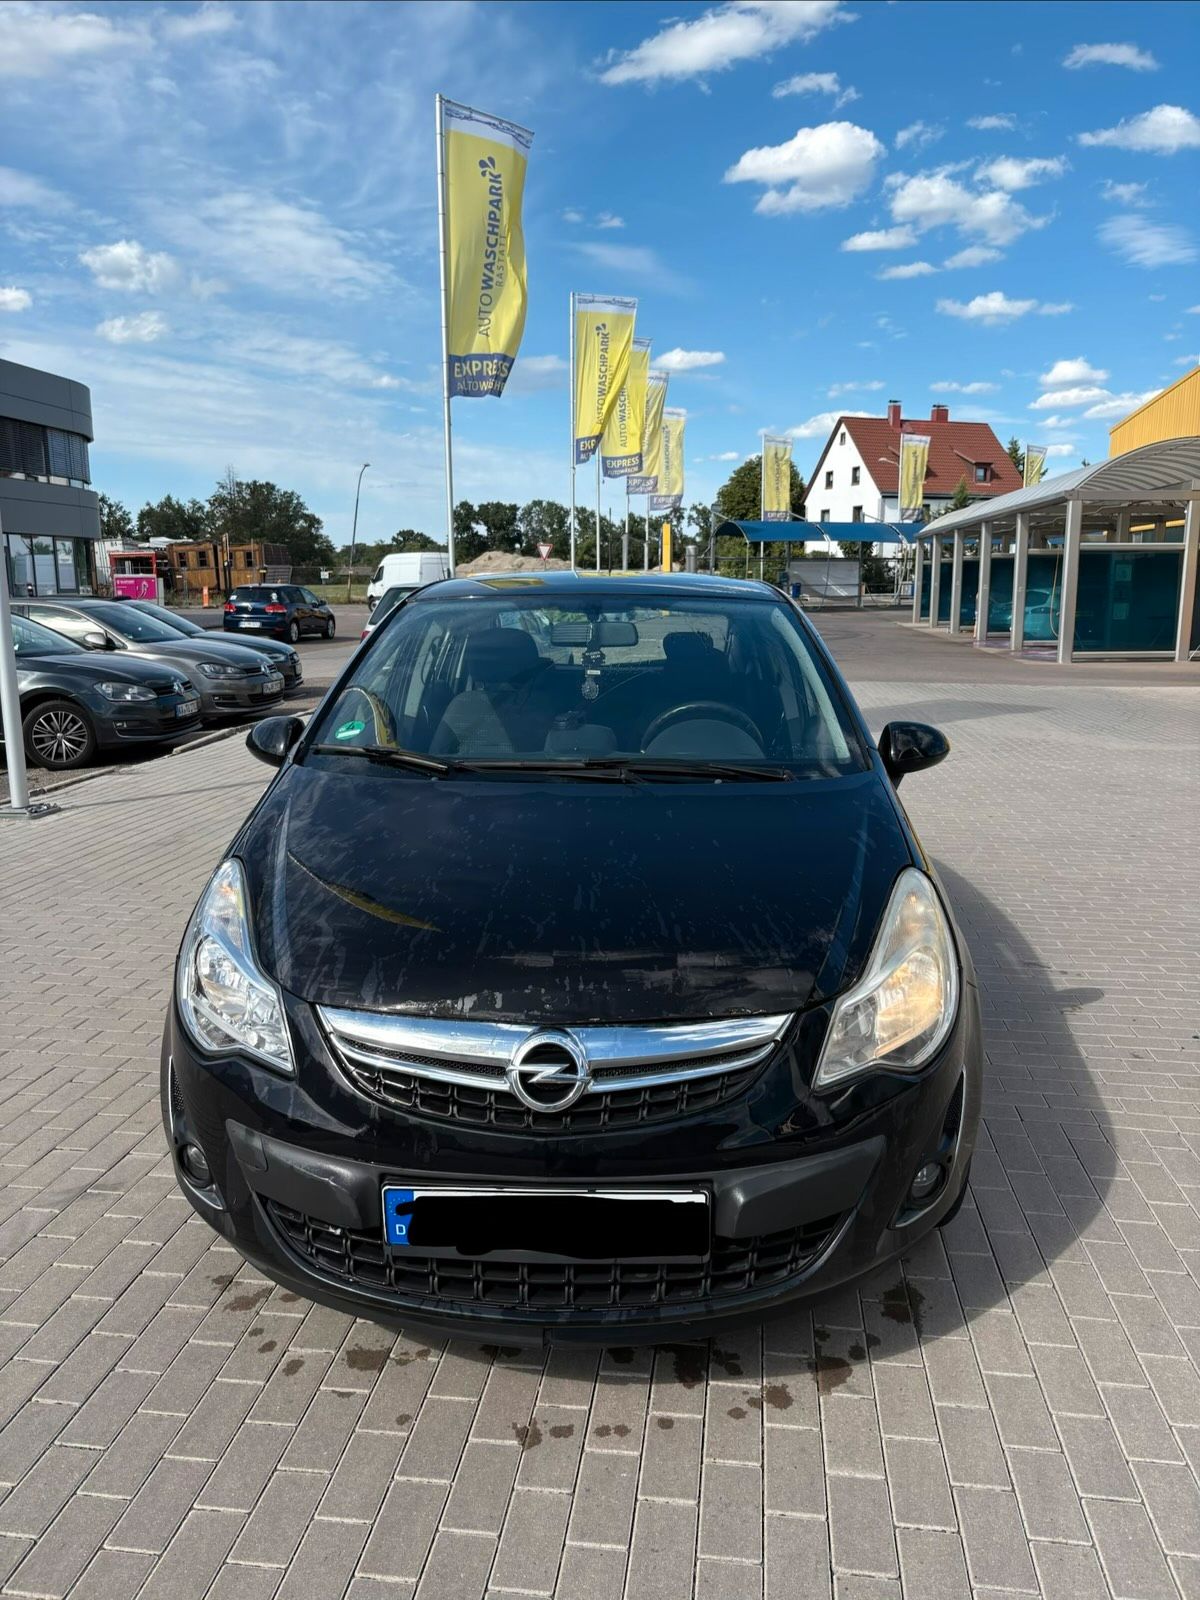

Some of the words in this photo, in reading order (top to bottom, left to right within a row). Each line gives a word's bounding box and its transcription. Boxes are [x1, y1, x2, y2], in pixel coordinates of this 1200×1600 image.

[478, 171, 503, 338] AUTOWASCHPARK
[606, 456, 640, 468] EXPRESS
[395, 1223, 406, 1236] D
